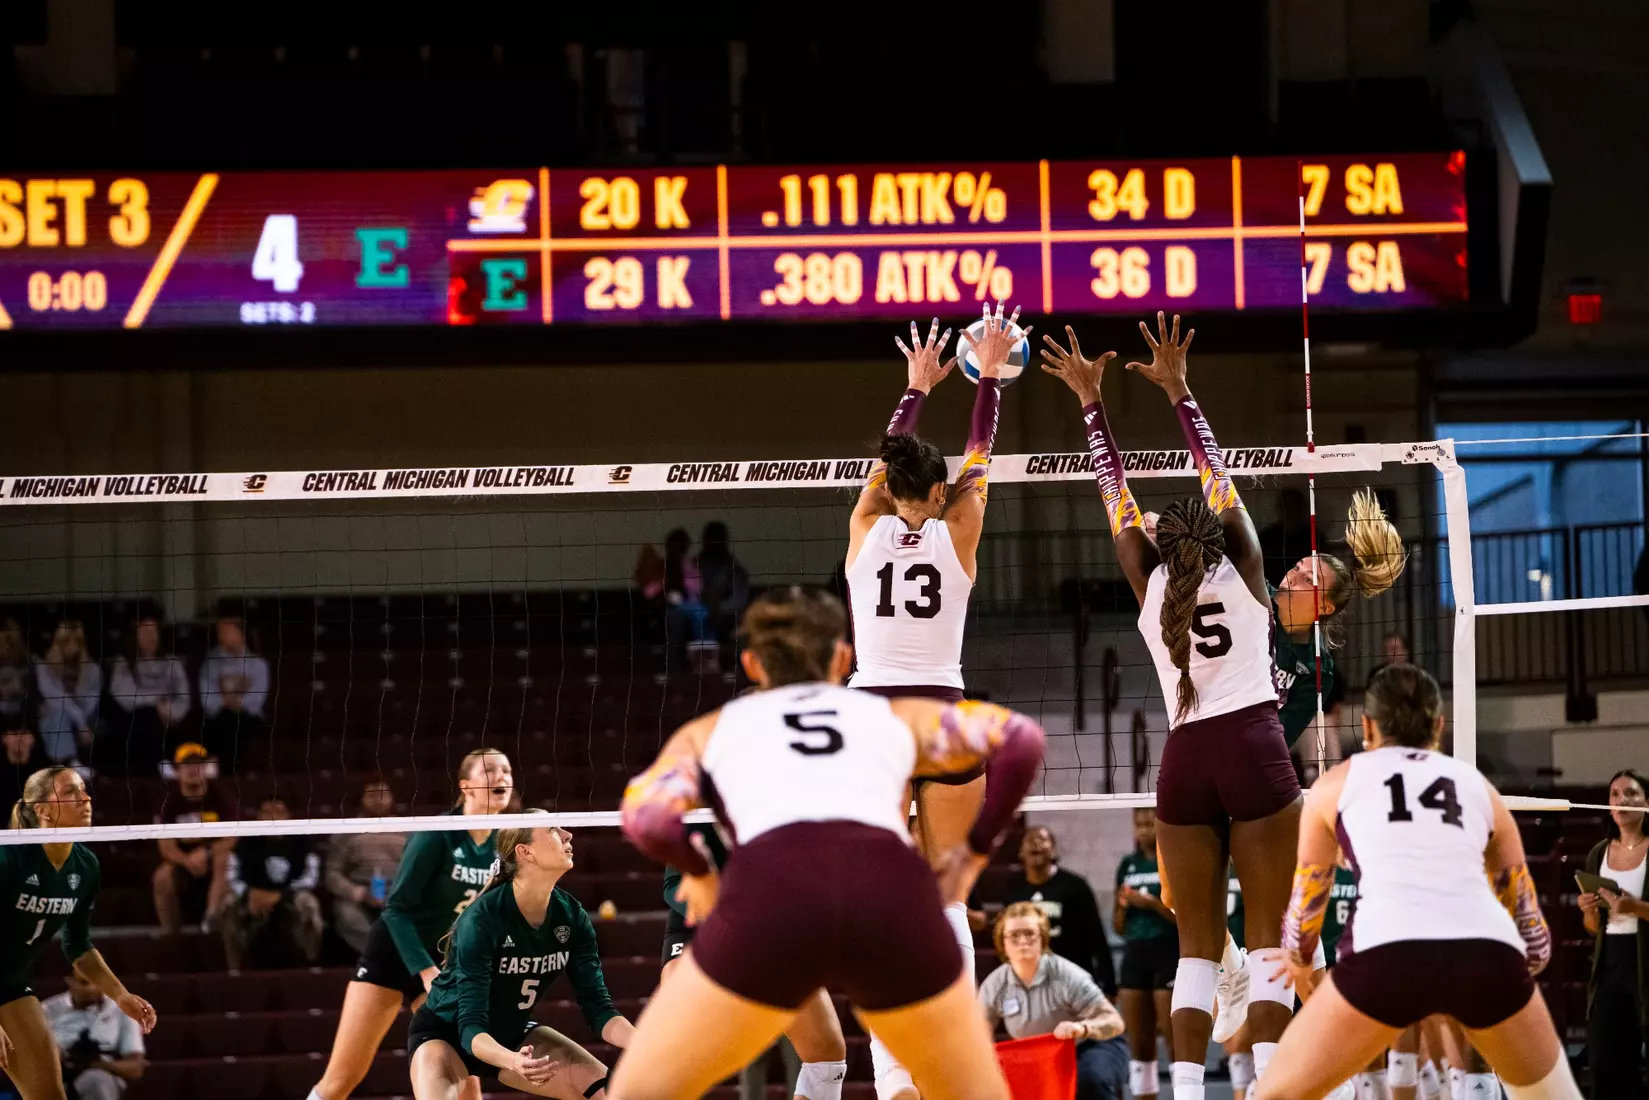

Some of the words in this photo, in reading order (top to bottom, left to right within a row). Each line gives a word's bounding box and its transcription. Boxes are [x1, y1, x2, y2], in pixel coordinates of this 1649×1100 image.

[0, 178, 95, 248] SET
[108, 178, 151, 248] 3
[579, 176, 640, 230] 20
[653, 176, 691, 230] K
[761, 173, 858, 228] .111
[869, 171, 1008, 228] ATK%
[1087, 167, 1150, 222] 34
[1163, 166, 1197, 221] D
[1302, 163, 1331, 218] 7
[1344, 162, 1405, 217] SA
[251, 213, 303, 293] 4
[760, 250, 864, 307] .380
[874, 249, 1014, 305] ATK%
[1090, 244, 1151, 300] 36
[1164, 244, 1198, 299] D
[1305, 242, 1333, 296] 7
[1347, 240, 1407, 295] SA
[28, 270, 107, 311] 0:00
[583, 256, 644, 311] 29
[656, 255, 694, 310] K
[10, 477, 99, 498] MICHIGAN
[103, 474, 209, 496] VOLLEYBALL
[302, 470, 378, 492] CENTRAL
[382, 468, 469, 490] MICHIGAN
[472, 467, 575, 488] VOLLEYBALL
[666, 463, 741, 484] CENTRAL
[744, 461, 832, 482] MICHIGAN
[876, 562, 942, 619] 13
[1191, 602, 1233, 659] 5
[783, 710, 844, 756] 5
[1383, 772, 1465, 829] 14
[15, 892, 78, 915] EASTERN
[26, 918, 46, 945] 1
[1336, 900, 1351, 925] 6
[499, 951, 570, 975] EASTERN
[518, 979, 540, 1010] 5
